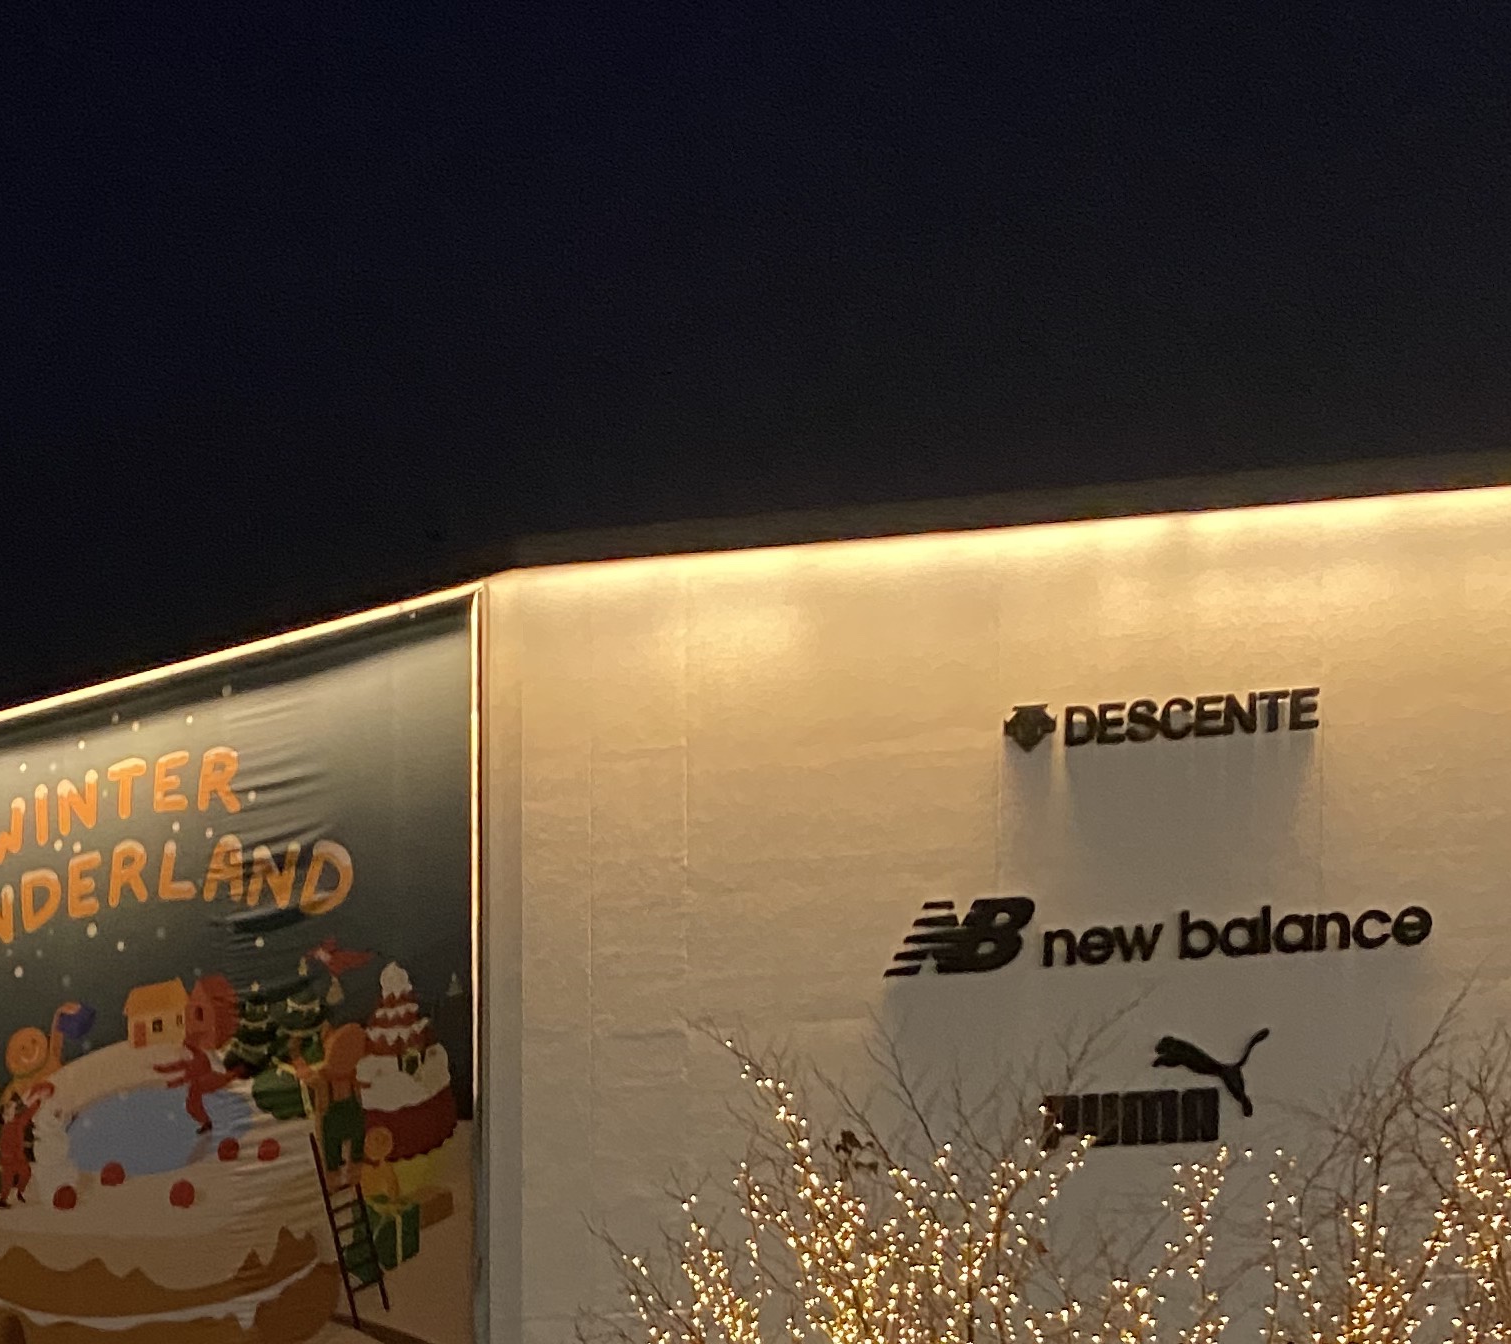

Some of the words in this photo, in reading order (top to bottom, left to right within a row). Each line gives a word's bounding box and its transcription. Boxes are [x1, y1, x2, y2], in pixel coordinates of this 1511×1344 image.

[1063, 687, 1320, 747] DESCENTE
[1041, 922, 1164, 968] new
[1178, 905, 1433, 961] balance
